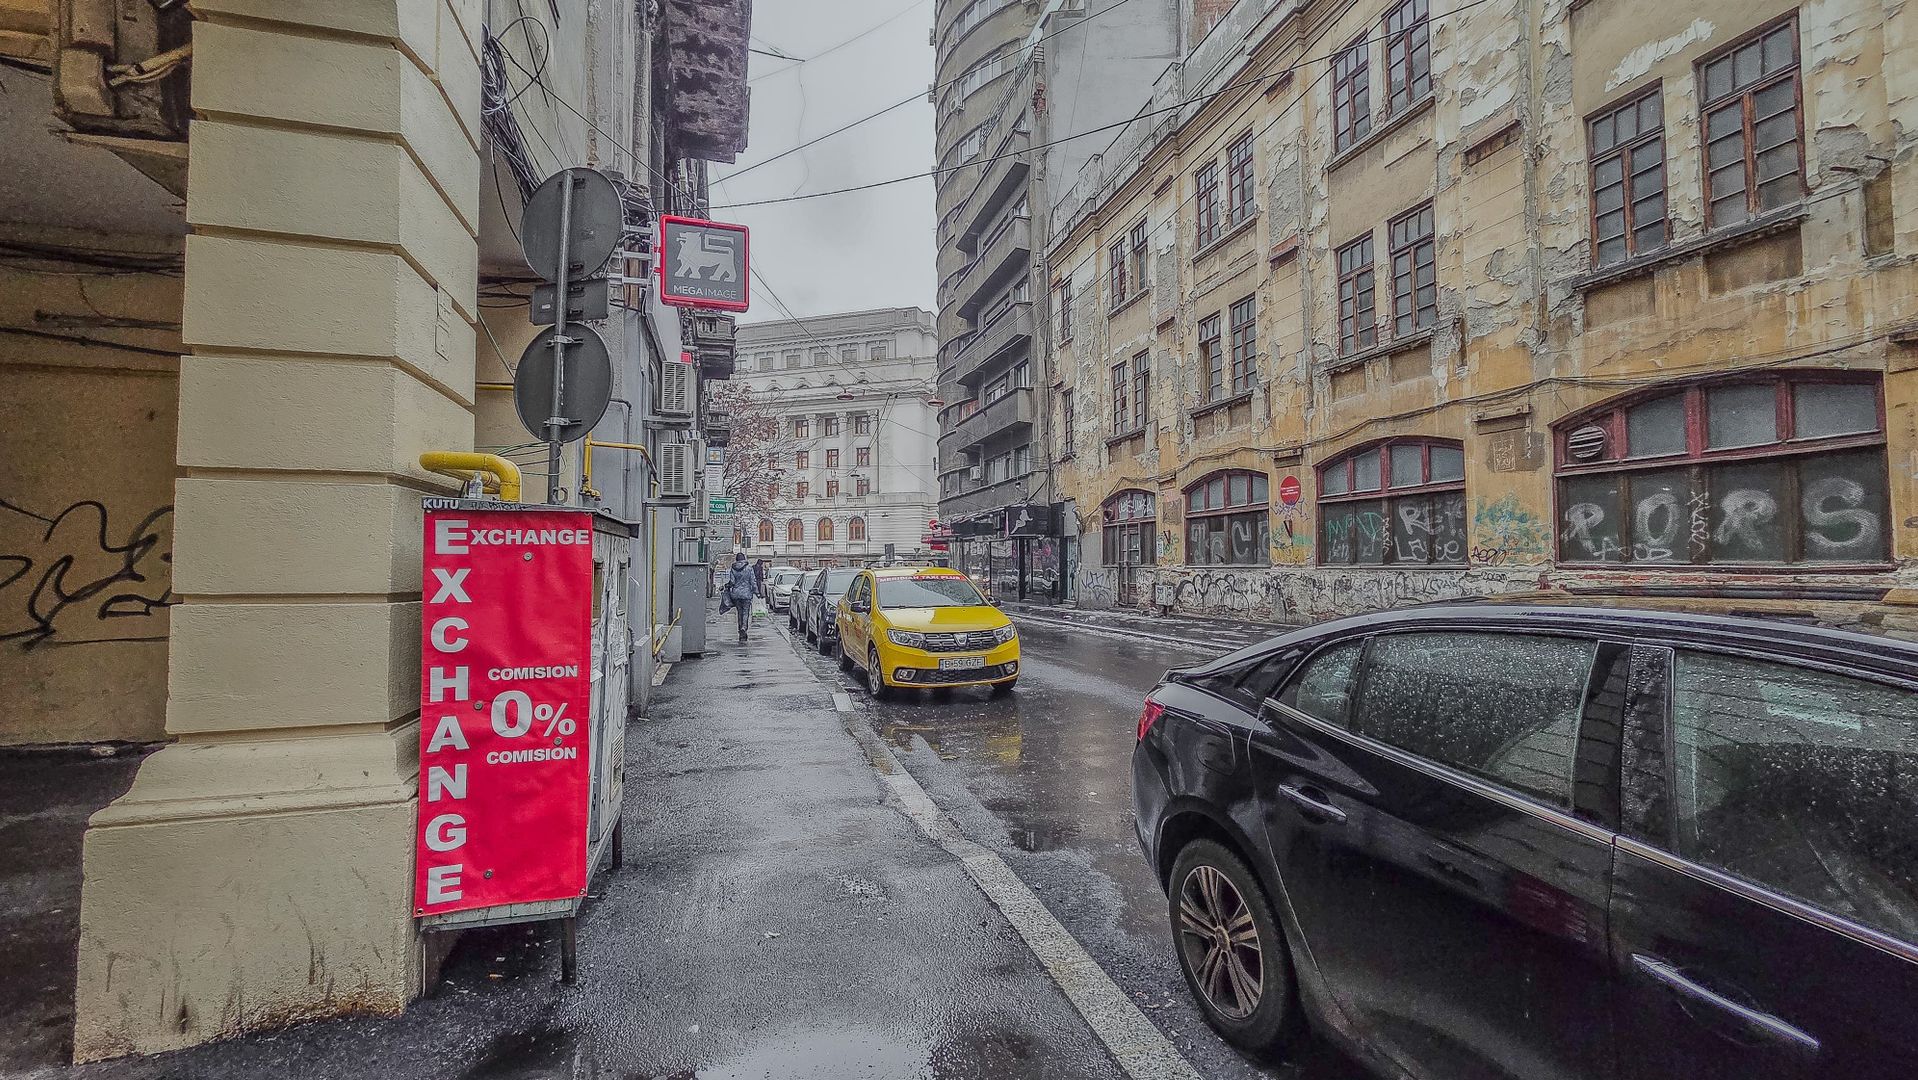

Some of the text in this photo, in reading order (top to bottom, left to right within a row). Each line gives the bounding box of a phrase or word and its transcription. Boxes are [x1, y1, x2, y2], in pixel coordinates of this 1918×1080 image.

[673, 285, 737, 299] MEGA IMAGE
[423, 499, 459, 510] KUTU
[434, 519, 590, 555] EXCHANGE
[487, 665, 578, 681] COMISION
[490, 690, 576, 738] 0%
[486, 746, 577, 765] COMISION
